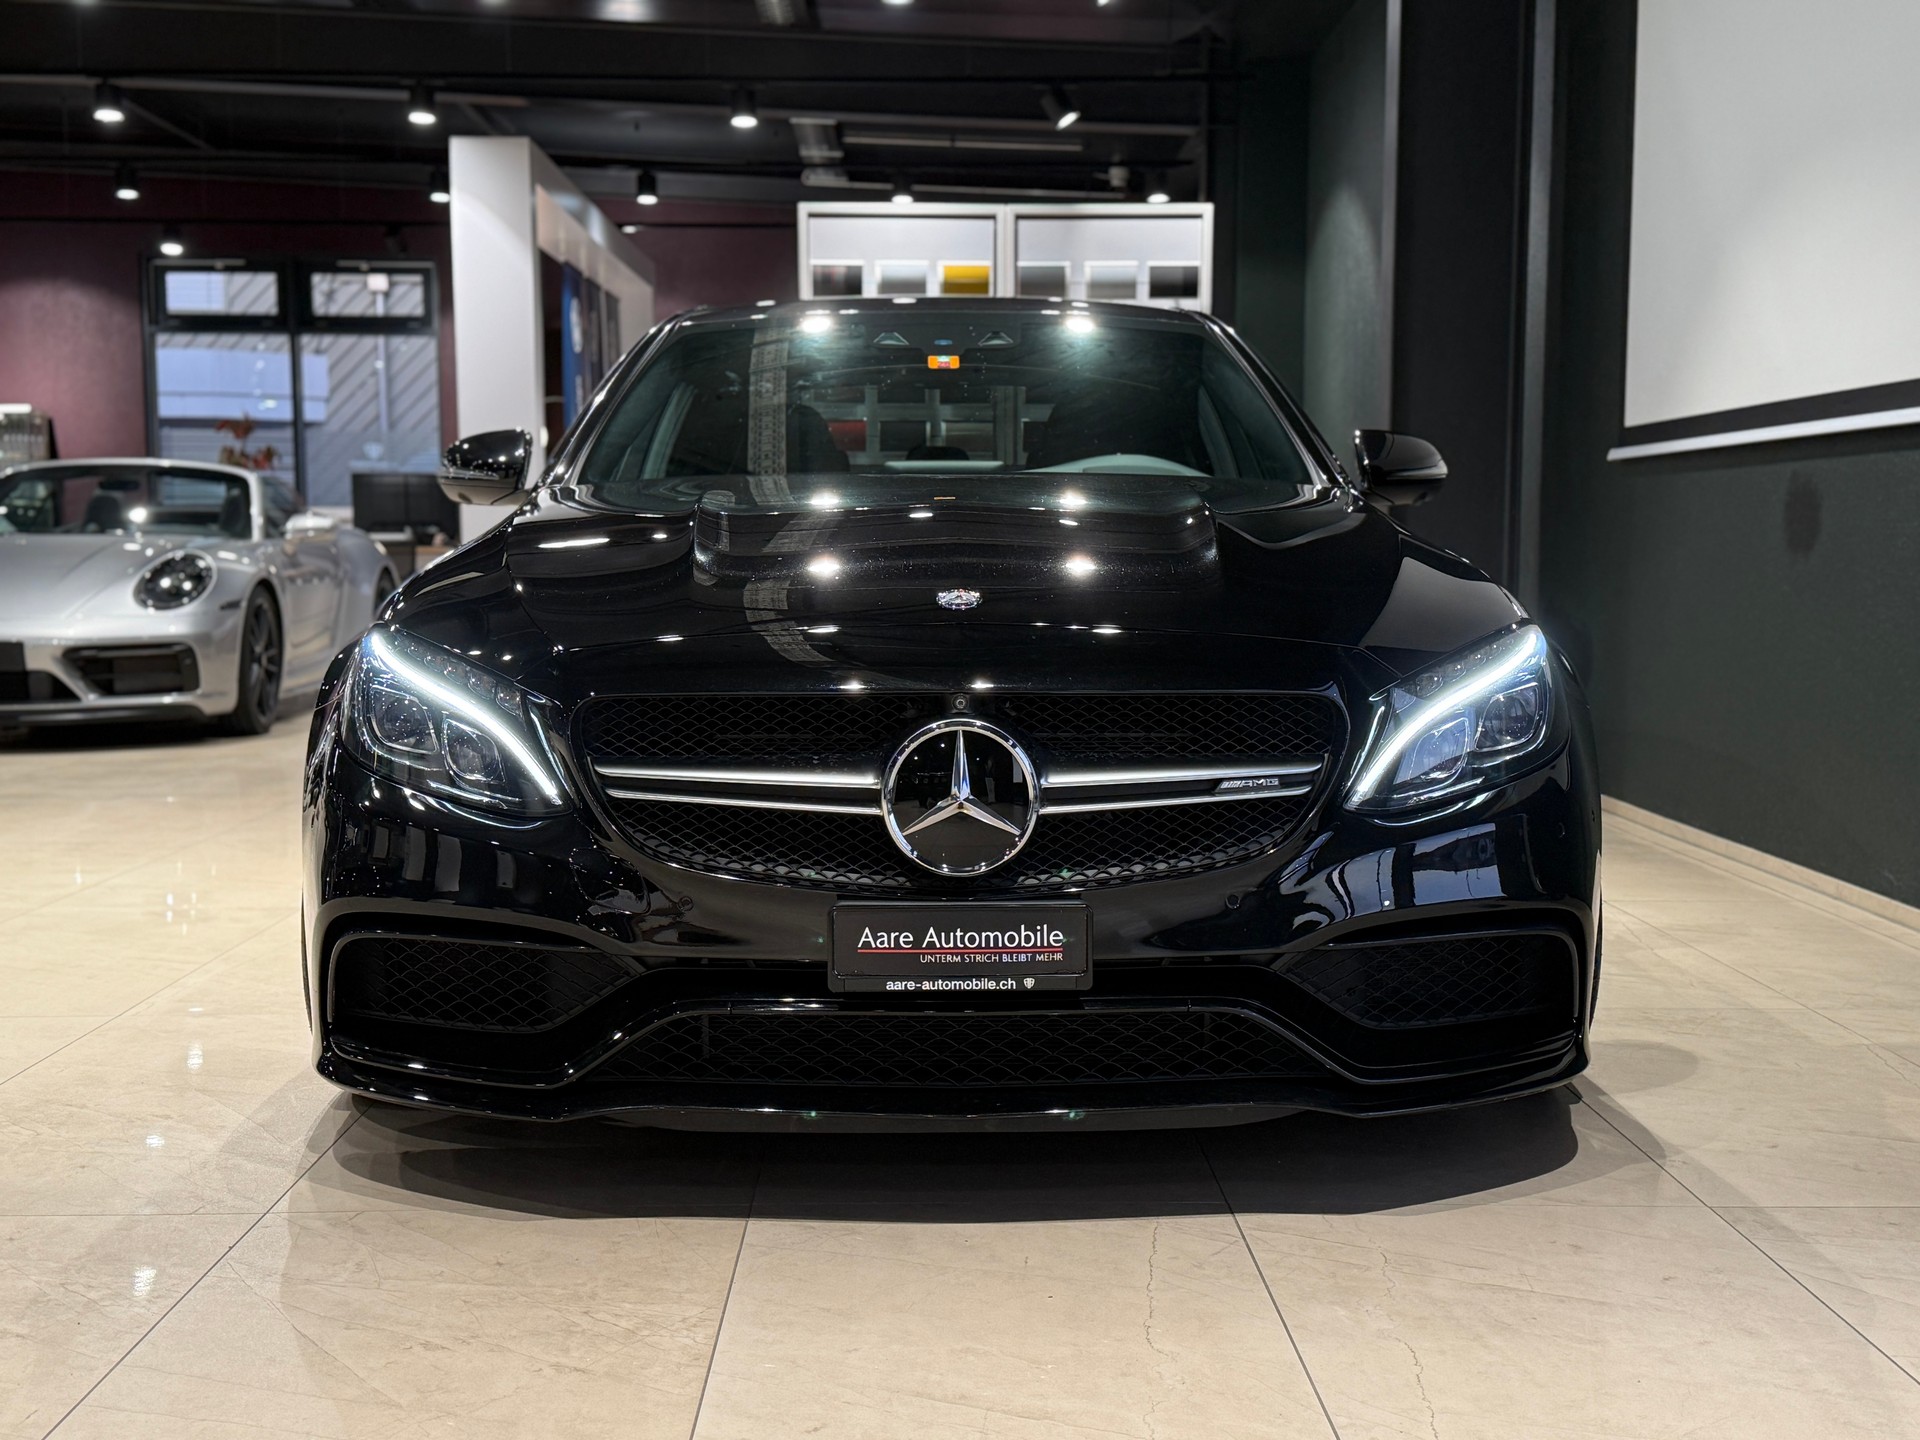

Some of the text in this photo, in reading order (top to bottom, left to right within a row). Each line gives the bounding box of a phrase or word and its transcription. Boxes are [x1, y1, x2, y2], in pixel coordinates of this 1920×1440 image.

[858, 924, 1064, 948] Aare Automobile
[920, 952, 1064, 963] UNTERM STRICH BLEIBT MEHR
[886, 978, 1016, 991] aare-automobile.ch
